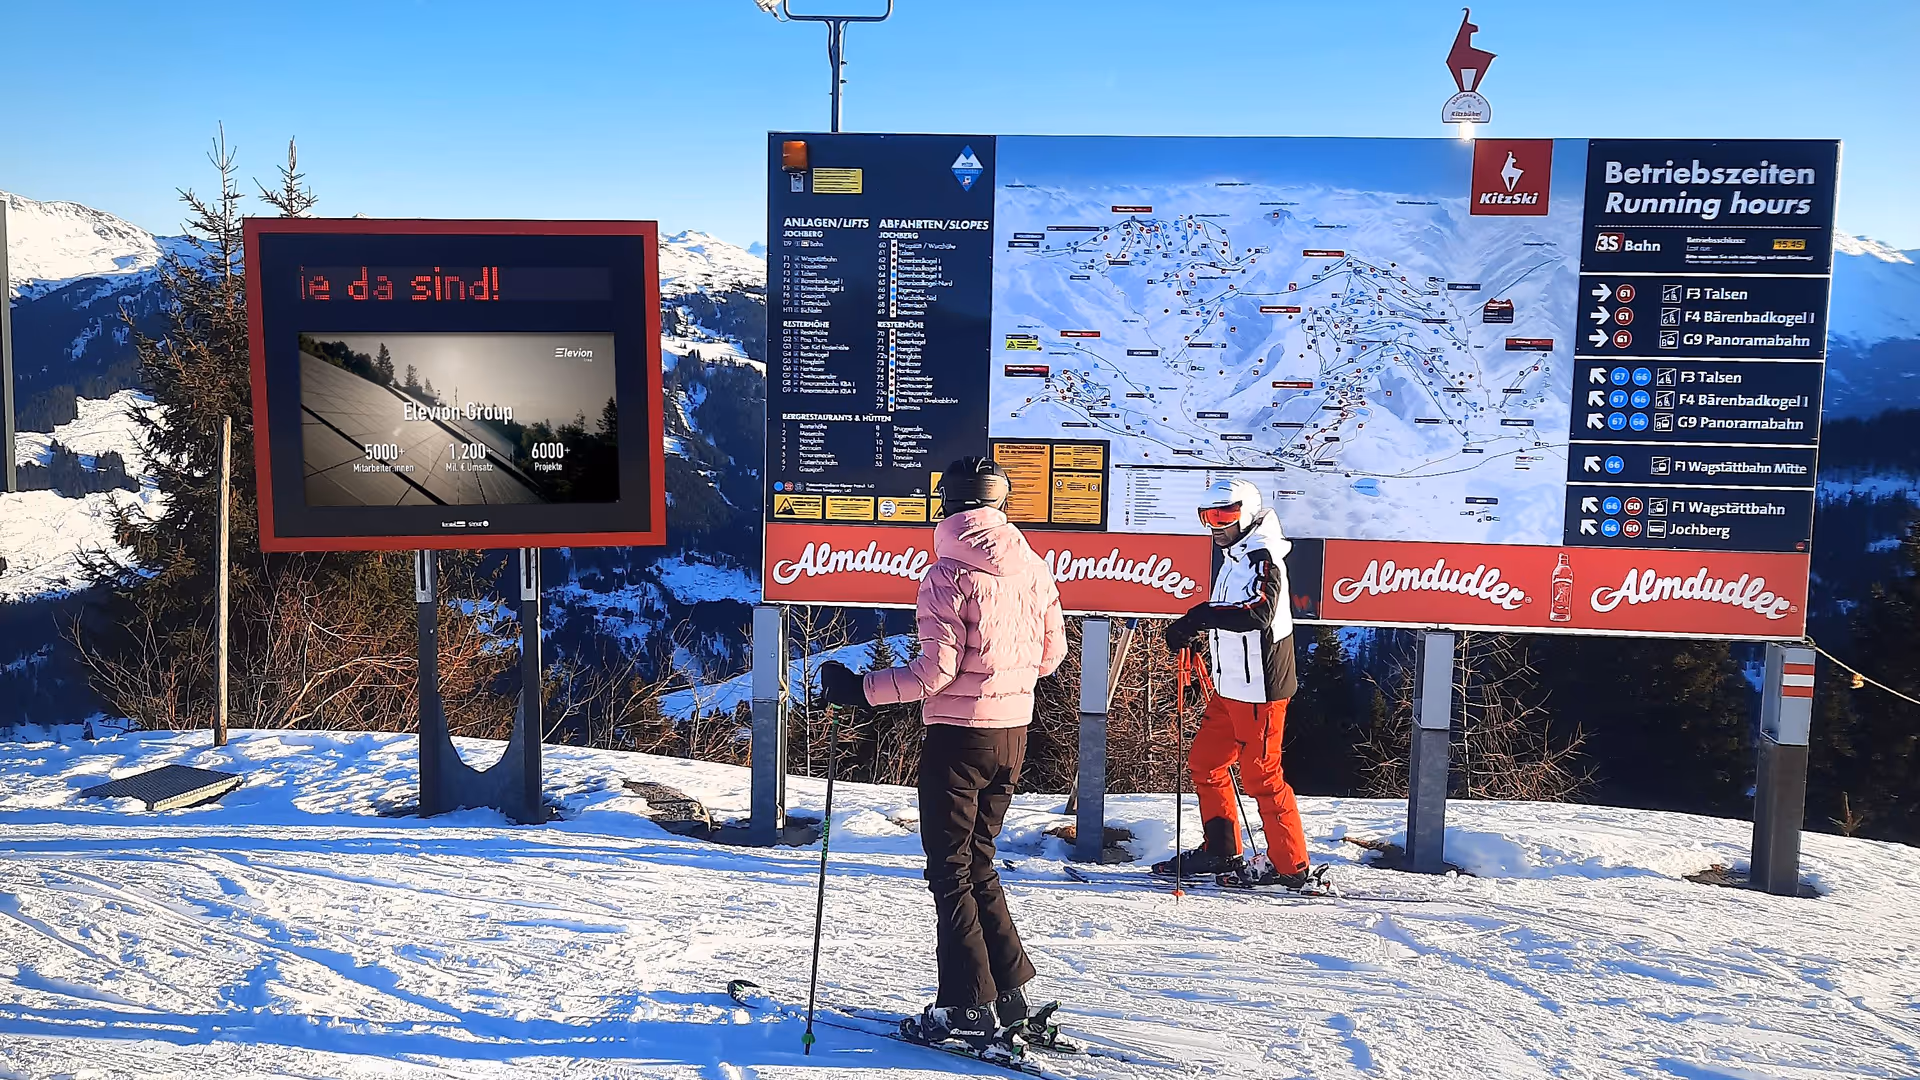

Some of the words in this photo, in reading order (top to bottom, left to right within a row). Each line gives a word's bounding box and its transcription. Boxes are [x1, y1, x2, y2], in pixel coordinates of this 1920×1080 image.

[1605, 160, 1815, 184] Betriebszeiten
[1480, 193, 1539, 204] KitzSki
[1605, 191, 1721, 220] Running
[1729, 191, 1811, 214] hours
[784, 218, 869, 228] ANLAGEN/LIFTS
[879, 219, 989, 230] ABFAHRTEN/SLOPES
[1625, 240, 1661, 251] Bahn
[347, 266, 393, 300] da
[411, 266, 499, 301] sind!
[1622, 289, 1630, 299] 61
[1686, 289, 1700, 299] F3
[1704, 288, 1748, 300] Talsen
[1618, 312, 1629, 320] 61
[1684, 311, 1701, 322] F4
[1704, 310, 1807, 326] Bärenbadkogel
[1617, 335, 1627, 343] 61
[1683, 334, 1702, 345] G9
[1706, 334, 1810, 347] Panoramabahn
[554, 348, 592, 358] Elevion
[1680, 372, 1695, 382] F3
[1698, 371, 1742, 383] Talsen
[1679, 394, 1695, 405] F4
[1698, 393, 1800, 410] Bärenbadkogel
[403, 402, 461, 421] Elevion
[466, 402, 513, 424] Group
[1678, 417, 1697, 428] G9
[1700, 417, 1804, 431] Panoramabahn
[365, 444, 405, 461] 5000+
[531, 442, 570, 459] 6000+
[467, 463, 493, 472] Umsatz
[534, 462, 563, 471] Projekte
[1688, 461, 1772, 476] Wagstättbahn
[1774, 464, 1807, 474] Mitte
[1627, 502, 1640, 511] 60
[1689, 502, 1786, 517] Wagstättbahn
[1669, 524, 1730, 539] Jochberg
[772, 541, 929, 584] Almdudl
[1332, 558, 1526, 610] Almdudler
[1590, 568, 1791, 620] Almdudler
